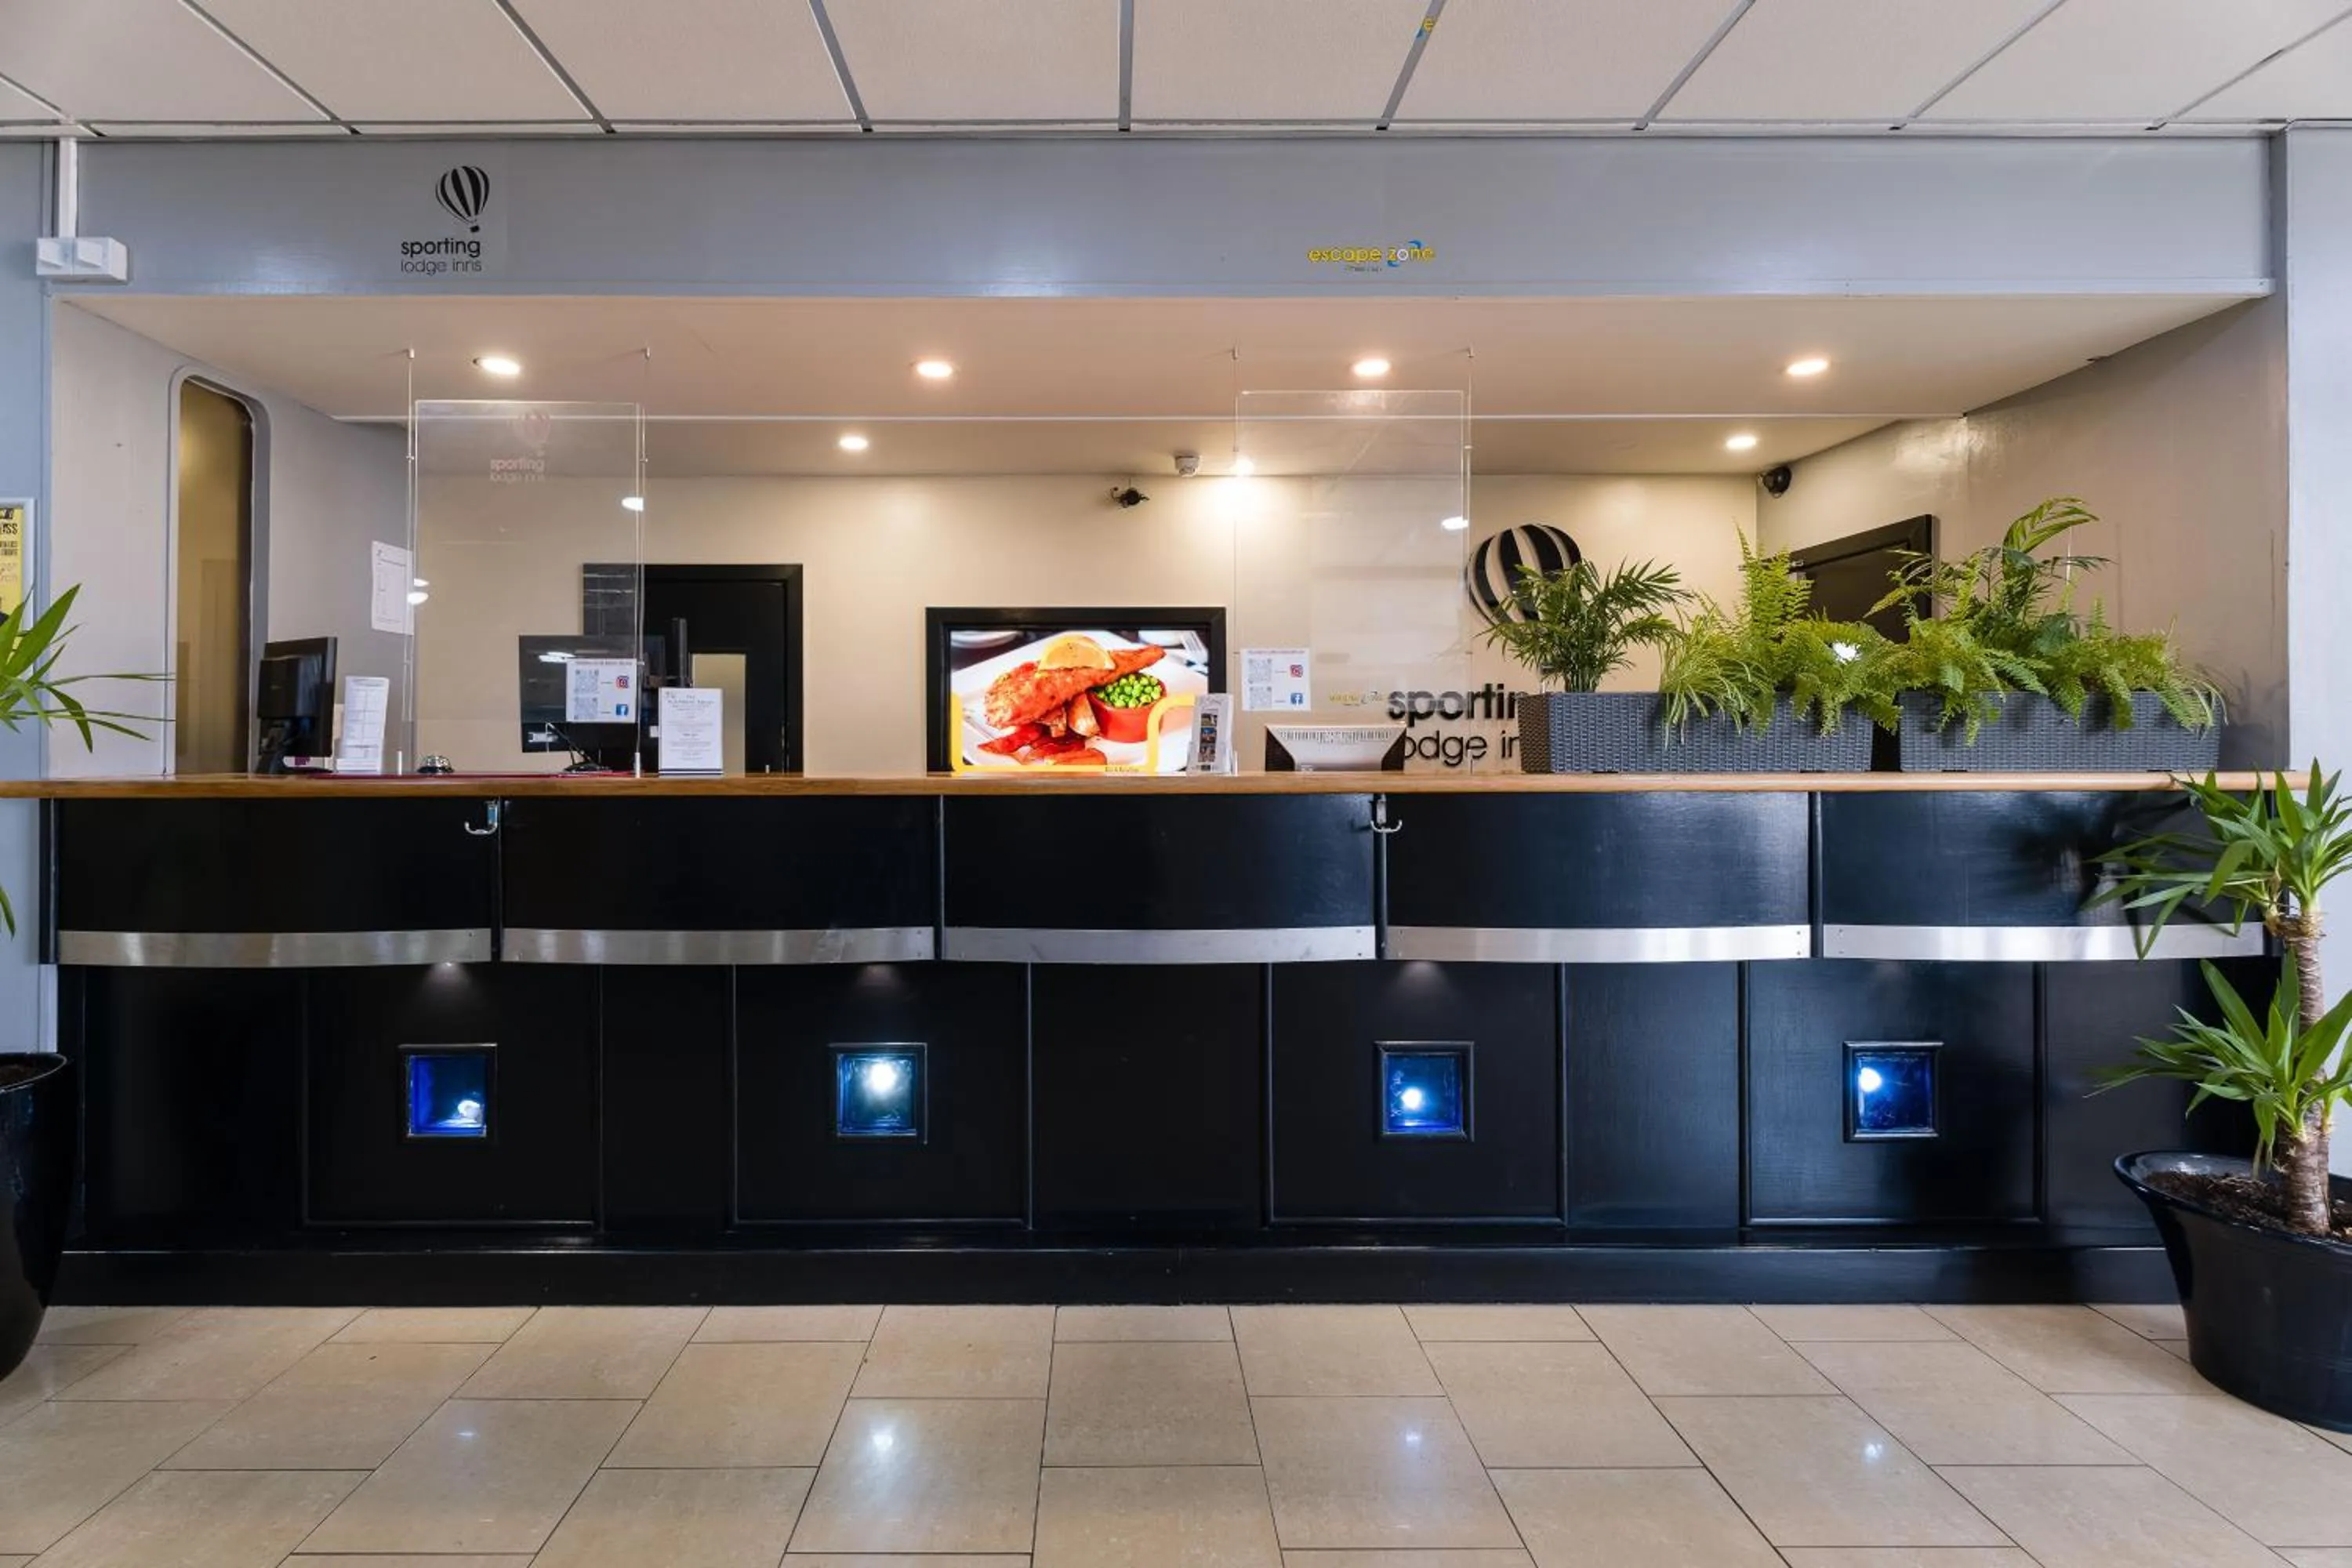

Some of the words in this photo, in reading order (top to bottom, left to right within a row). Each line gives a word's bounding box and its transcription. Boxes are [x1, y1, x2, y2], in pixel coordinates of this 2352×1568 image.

[401, 238, 481, 258] sporting
[1308, 247, 1382, 264] escape
[1385, 245, 1436, 262] zone
[401, 259, 447, 276] lodge
[452, 258, 482, 272] inns
[1388, 683, 1525, 728] sportin
[1404, 730, 1487, 766] odge
